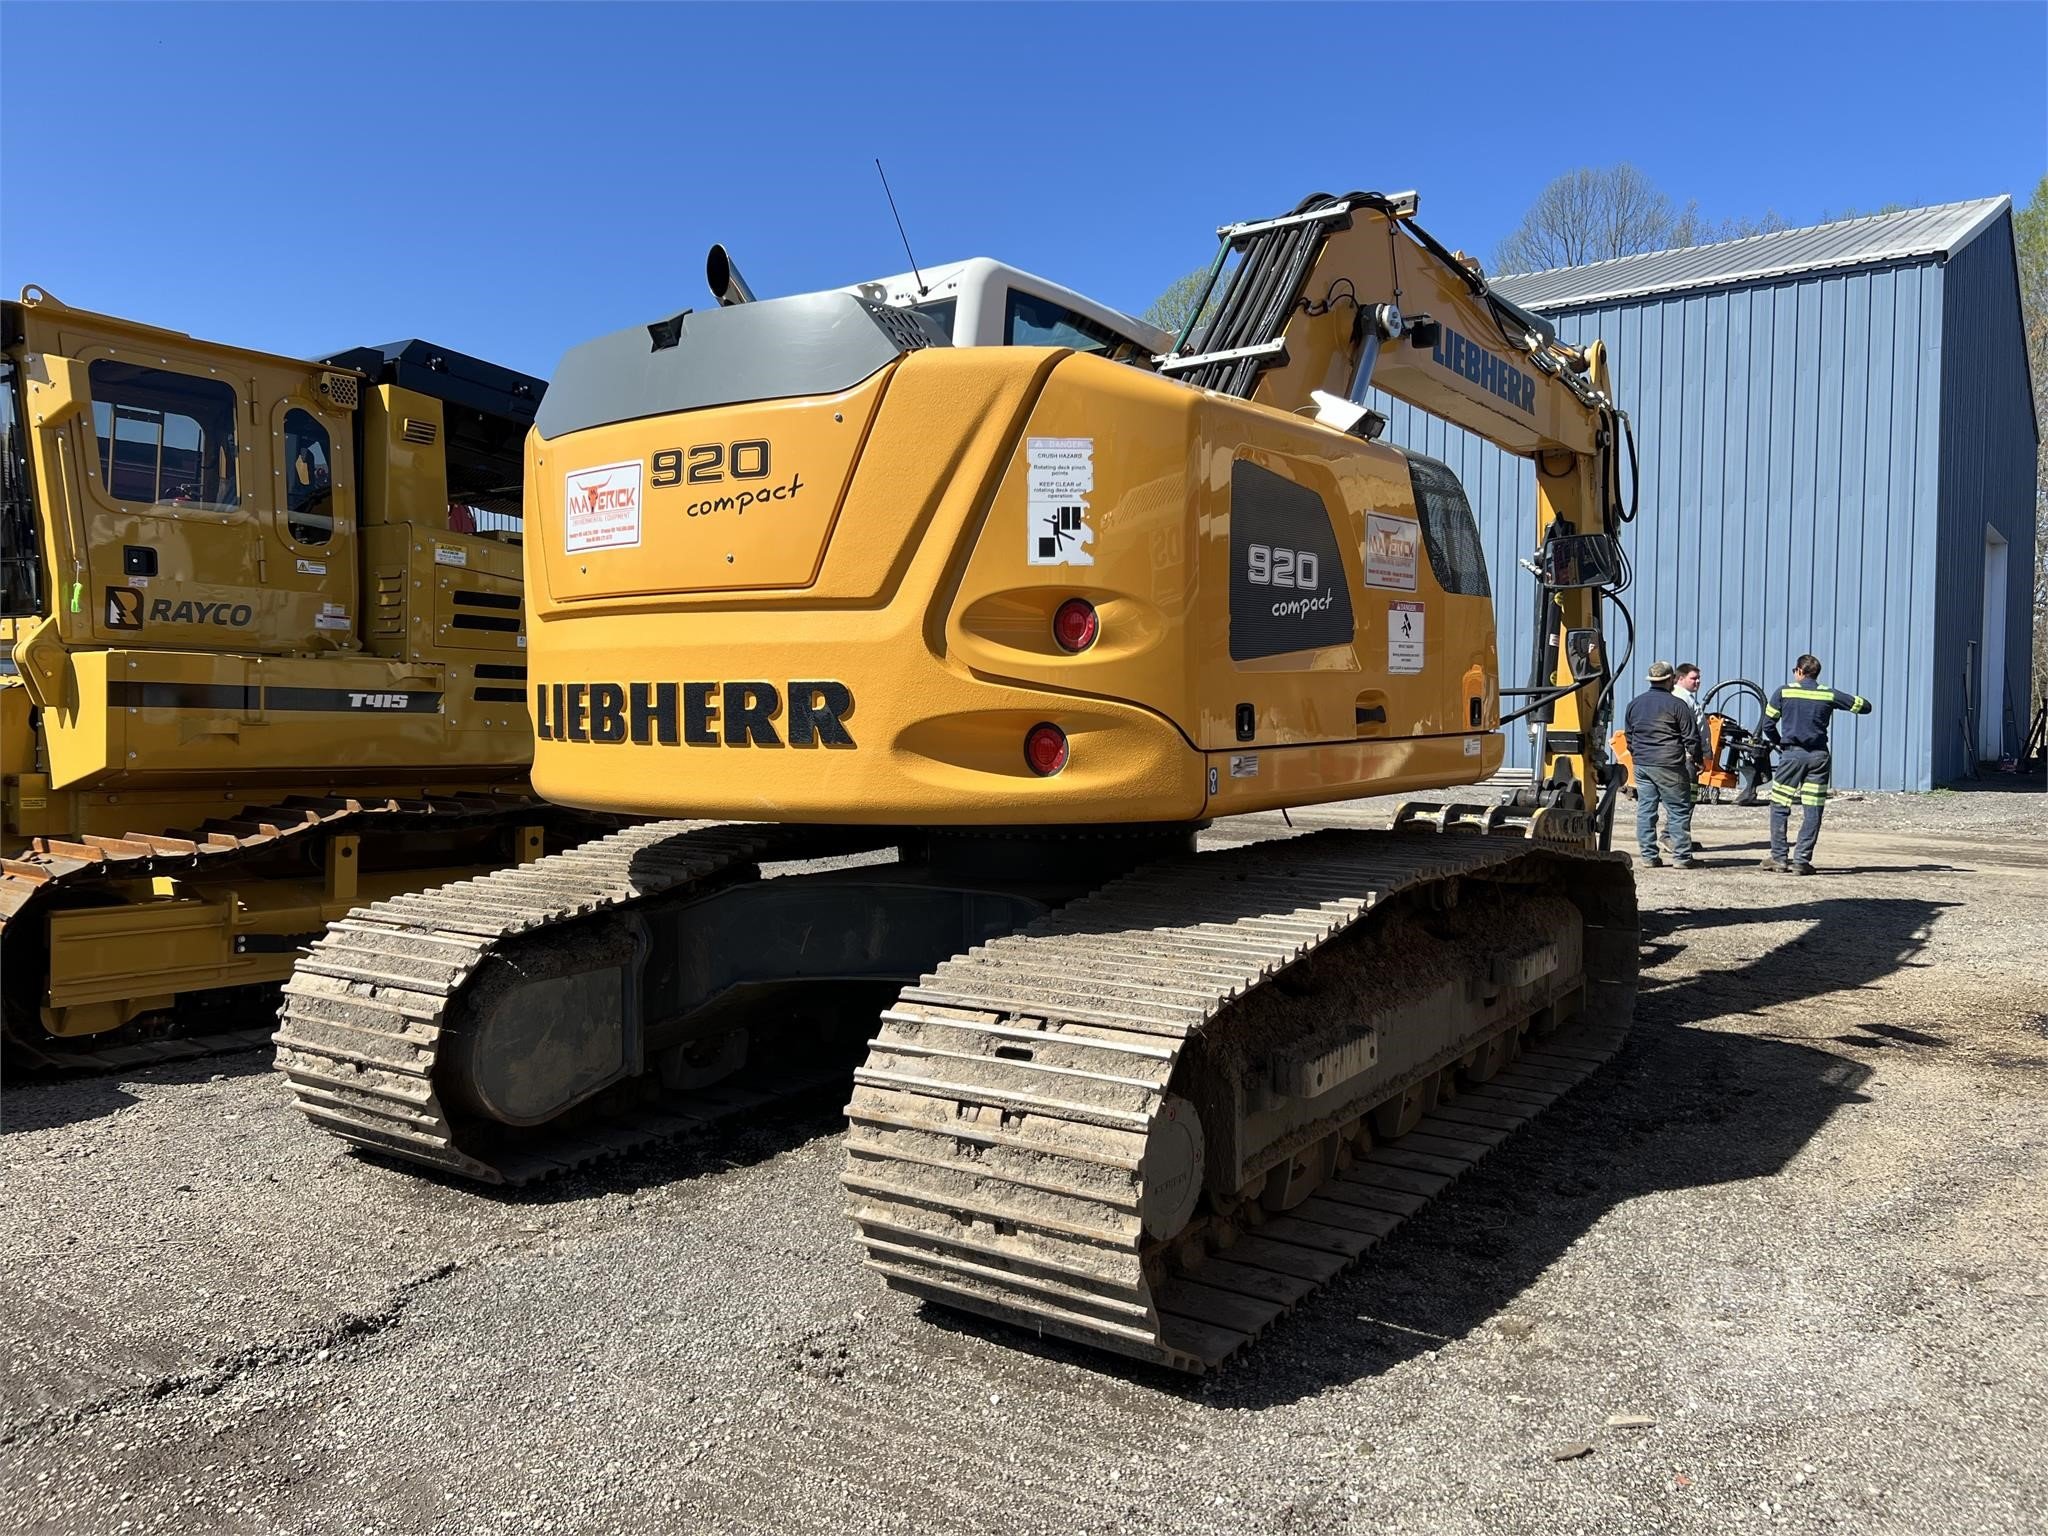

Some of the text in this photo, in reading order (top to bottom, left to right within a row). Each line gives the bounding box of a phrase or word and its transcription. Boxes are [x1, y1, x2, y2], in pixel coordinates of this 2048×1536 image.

[1433, 322, 1536, 416] LIEBHERR
[651, 438, 771, 489] 920
[687, 473, 803, 517] compact
[1248, 543, 1319, 591] 920
[150, 598, 252, 627] RAYCO
[1271, 587, 1333, 620] compact
[348, 693, 409, 709] T415
[537, 681, 857, 749] LIEBHERR
